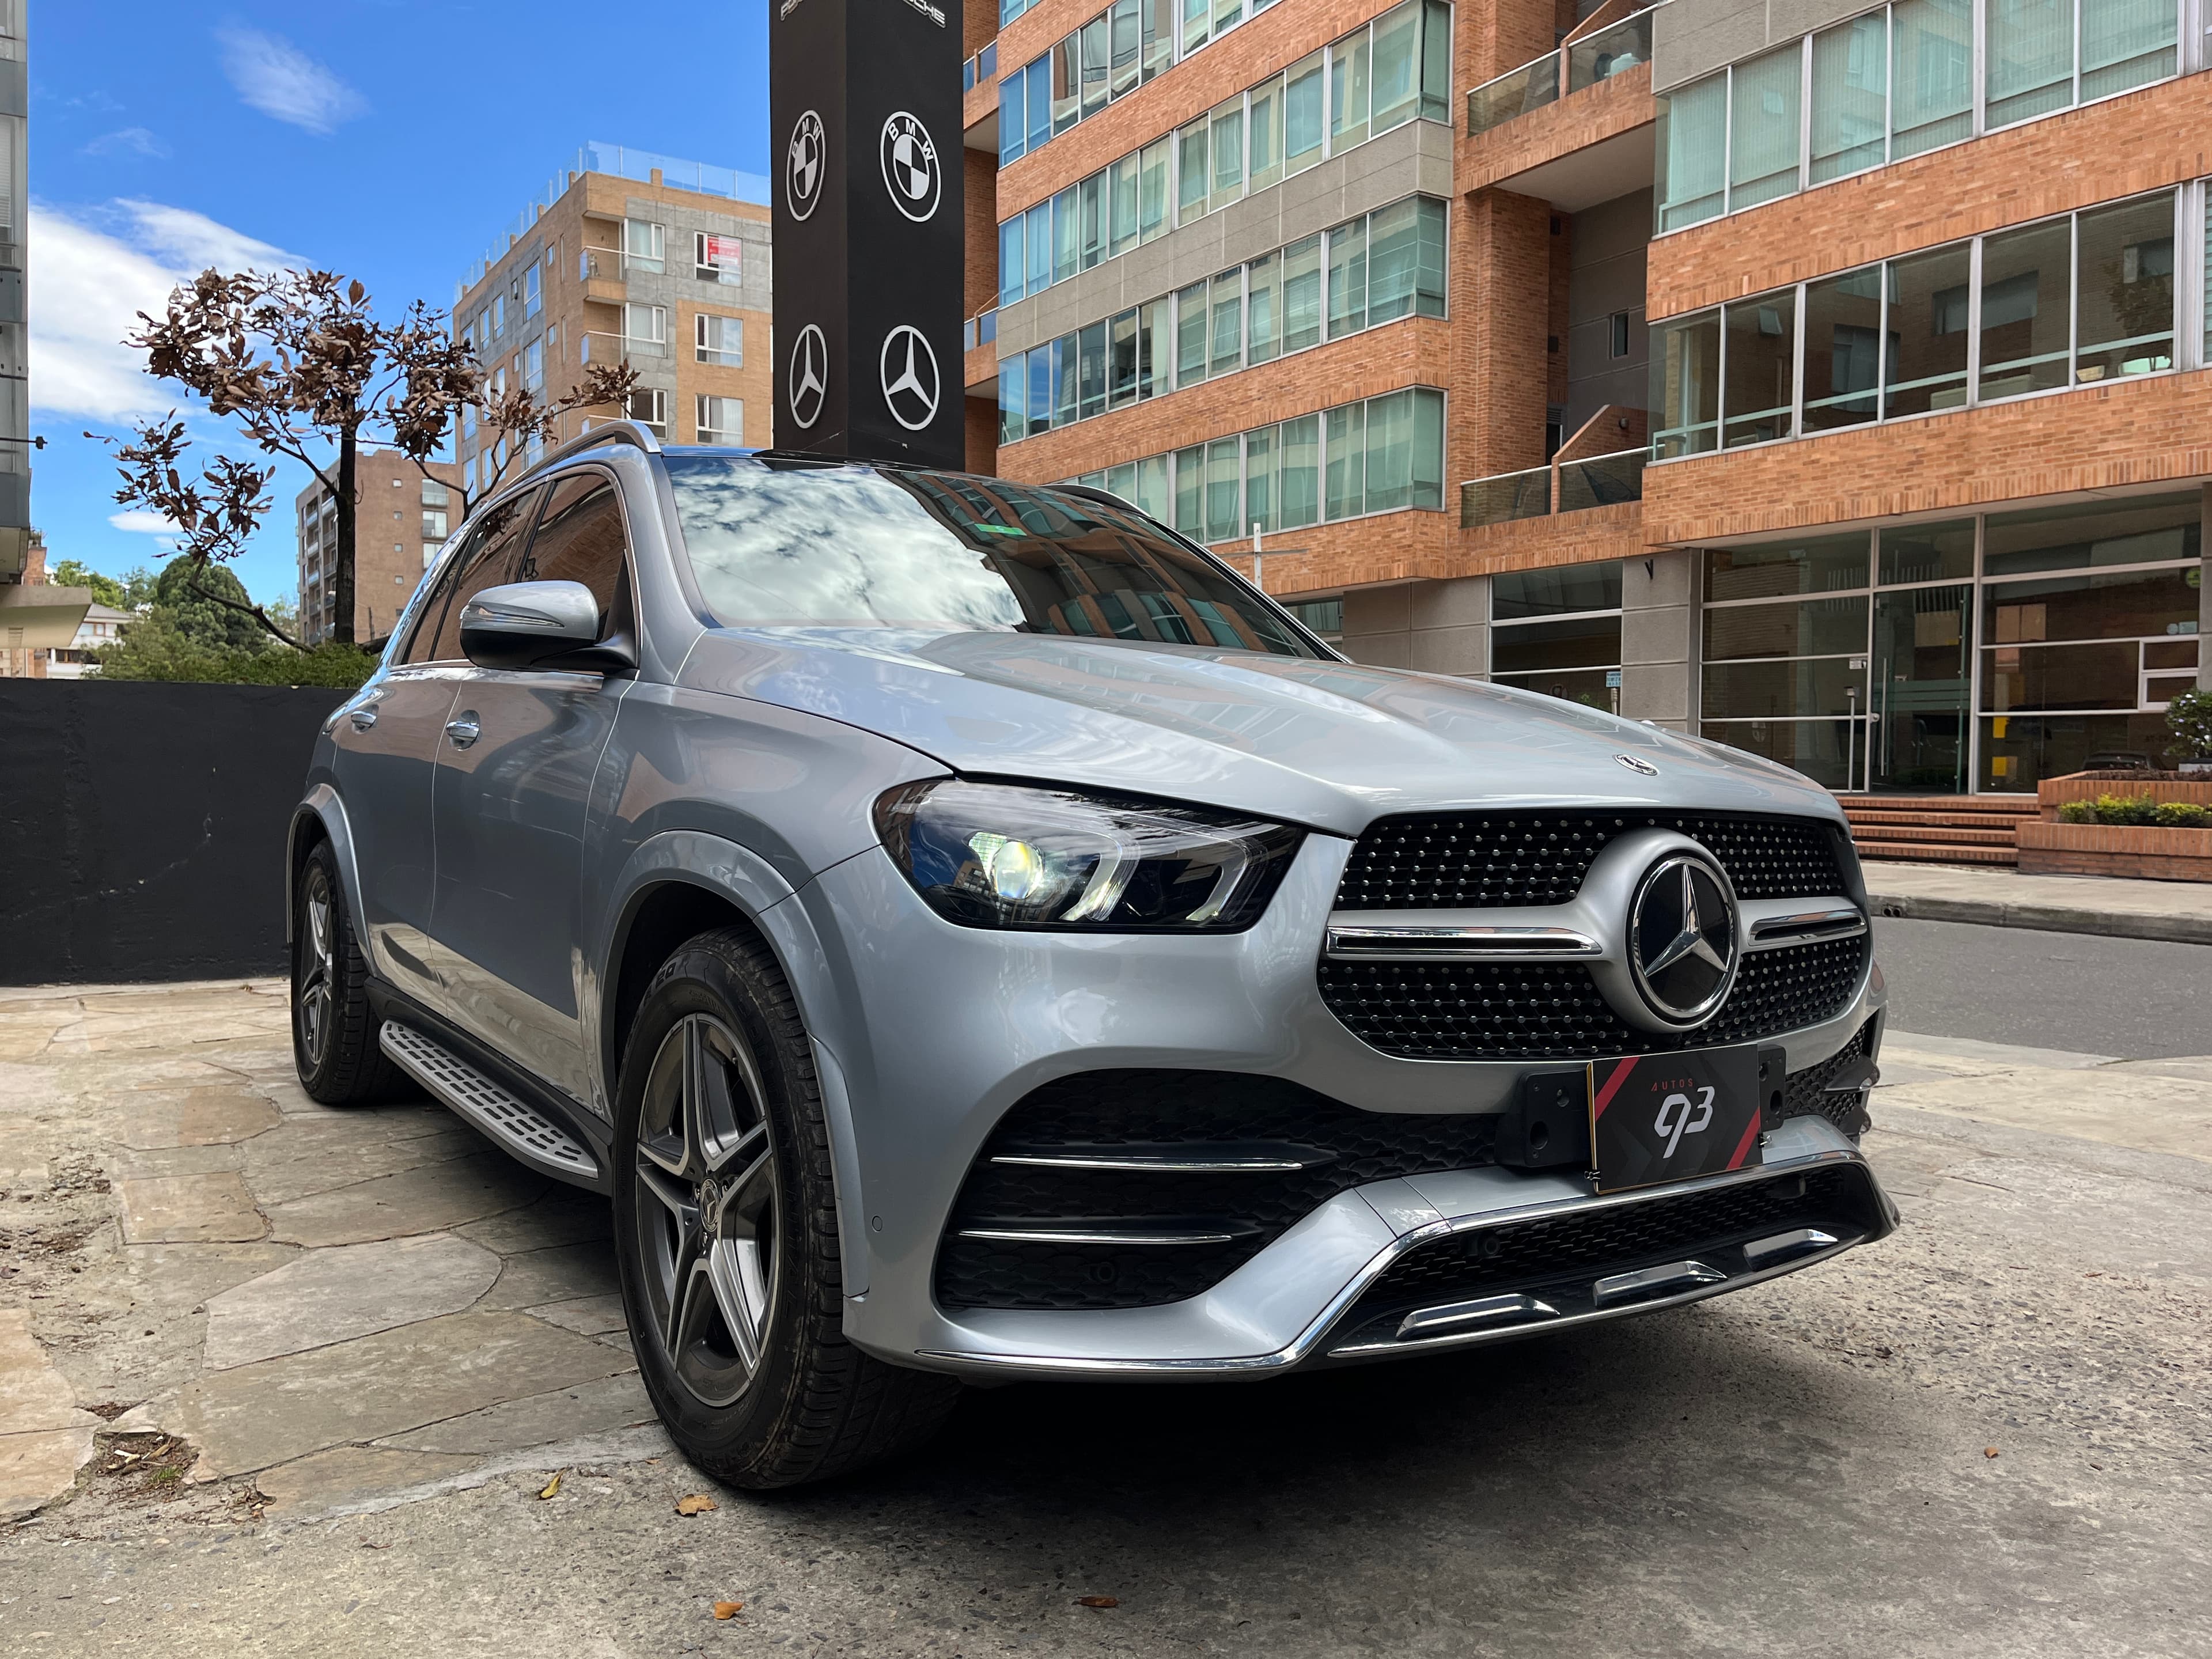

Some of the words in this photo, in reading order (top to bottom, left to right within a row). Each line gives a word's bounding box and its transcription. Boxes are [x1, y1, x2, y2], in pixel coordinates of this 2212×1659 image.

[887, 119, 933, 161] BMW
[1651, 1078, 1694, 1092] AUTOS
[1654, 1086, 1715, 1159] 93
